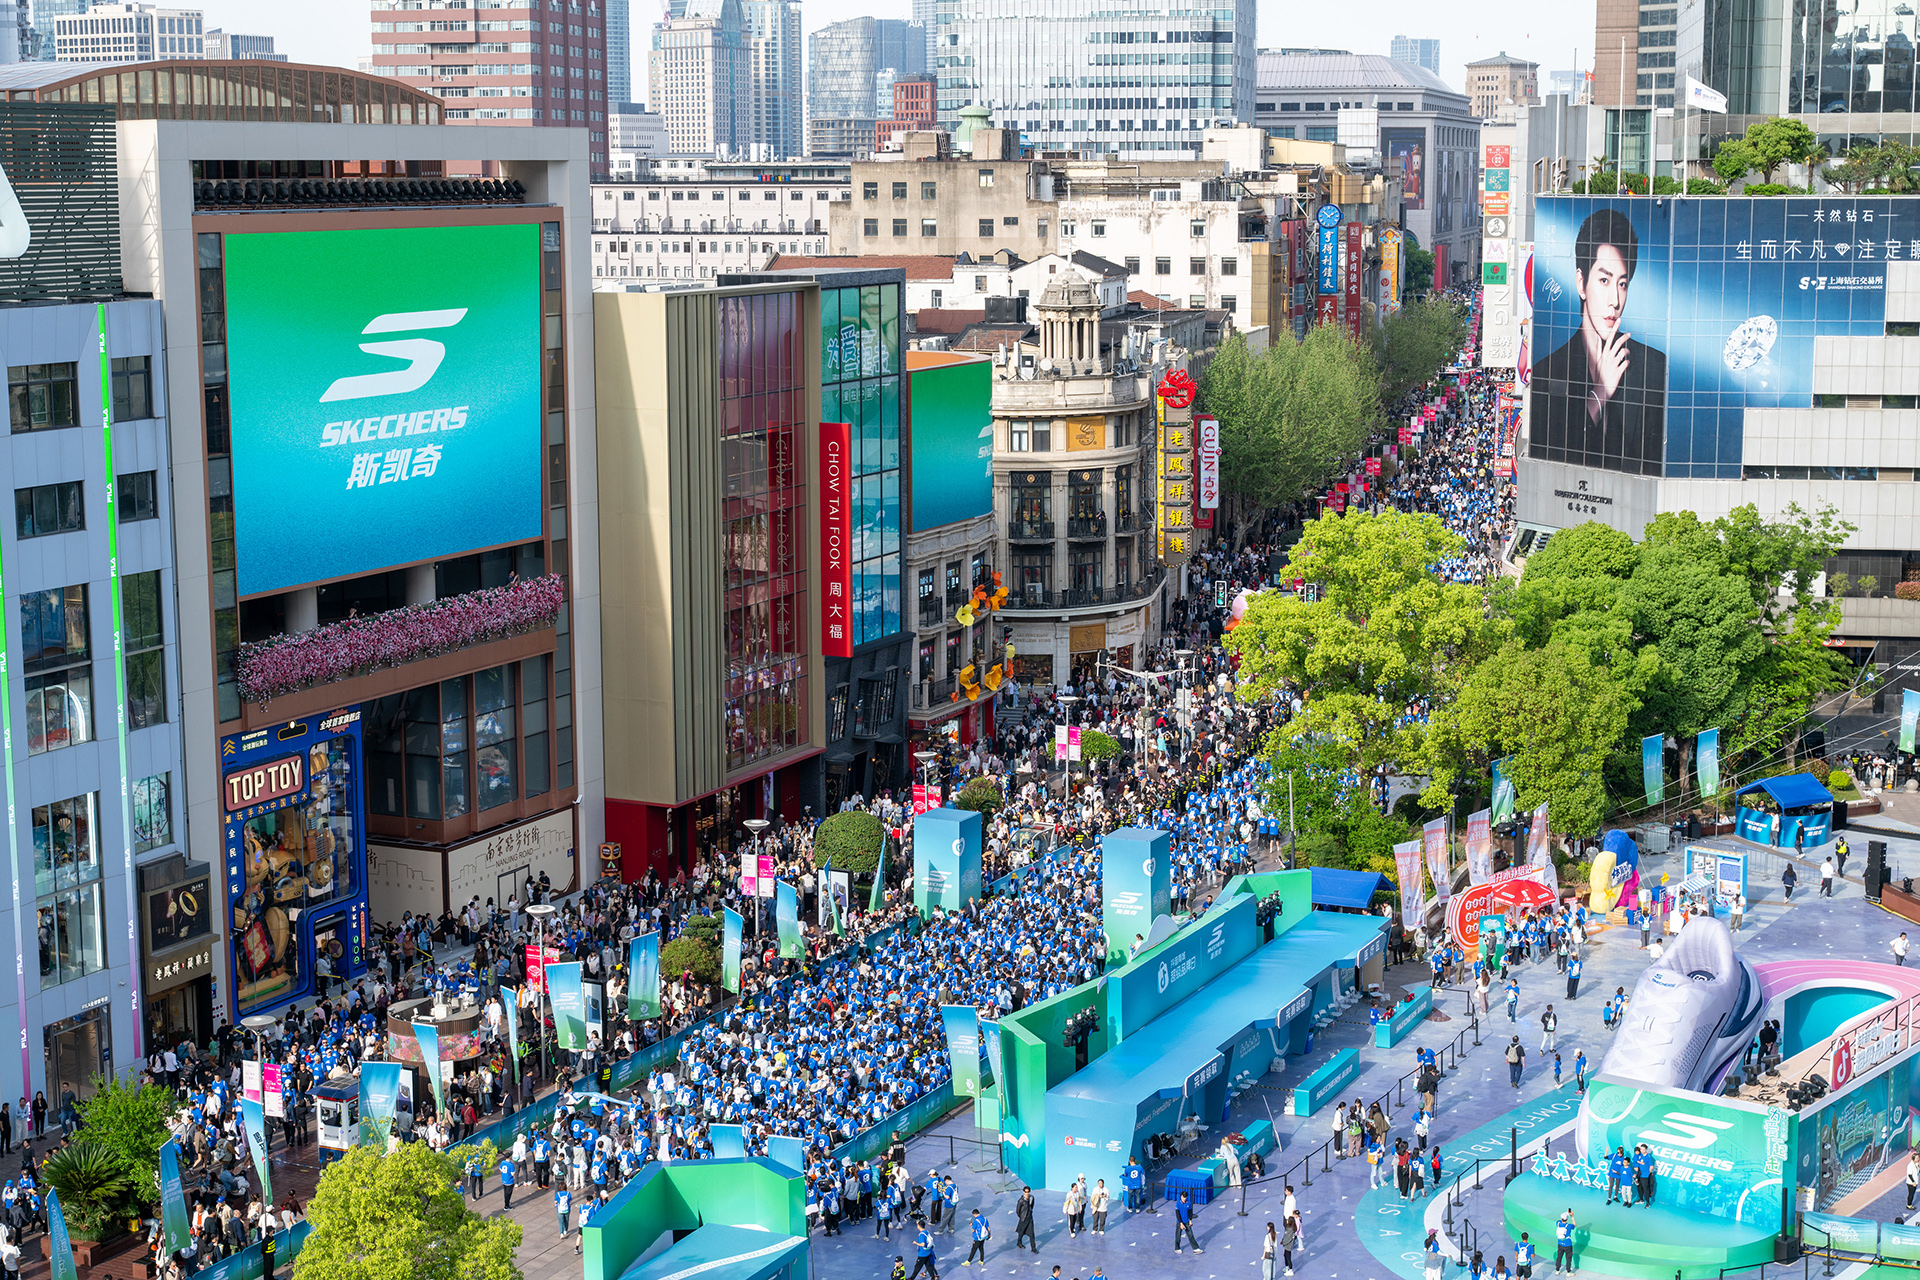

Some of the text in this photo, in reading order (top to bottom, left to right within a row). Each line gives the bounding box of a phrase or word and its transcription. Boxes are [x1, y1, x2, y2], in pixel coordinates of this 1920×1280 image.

[908, 20, 924, 28] AIA
[1813, 209, 1874, 222] 天然钻石
[1736, 240, 1827, 260] 生而不凡
[1828, 276, 1883, 285] 上海钻石交易所
[1491, 336, 1511, 346] 世界
[319, 405, 469, 448] SKECHERS
[346, 443, 443, 490] 斯凯奇
[828, 441, 841, 569] CHOW TAI FOOK
[1579, 494, 1613, 505] COLLECTION
[829, 582, 842, 639] 周大福
[319, 711, 361, 731] 全球首家旗舰店
[229, 759, 302, 804] TOP TOY
[495, 847, 534, 867] NANJING ROAD
[1316, 1075, 1341, 1101] SKECHERS
